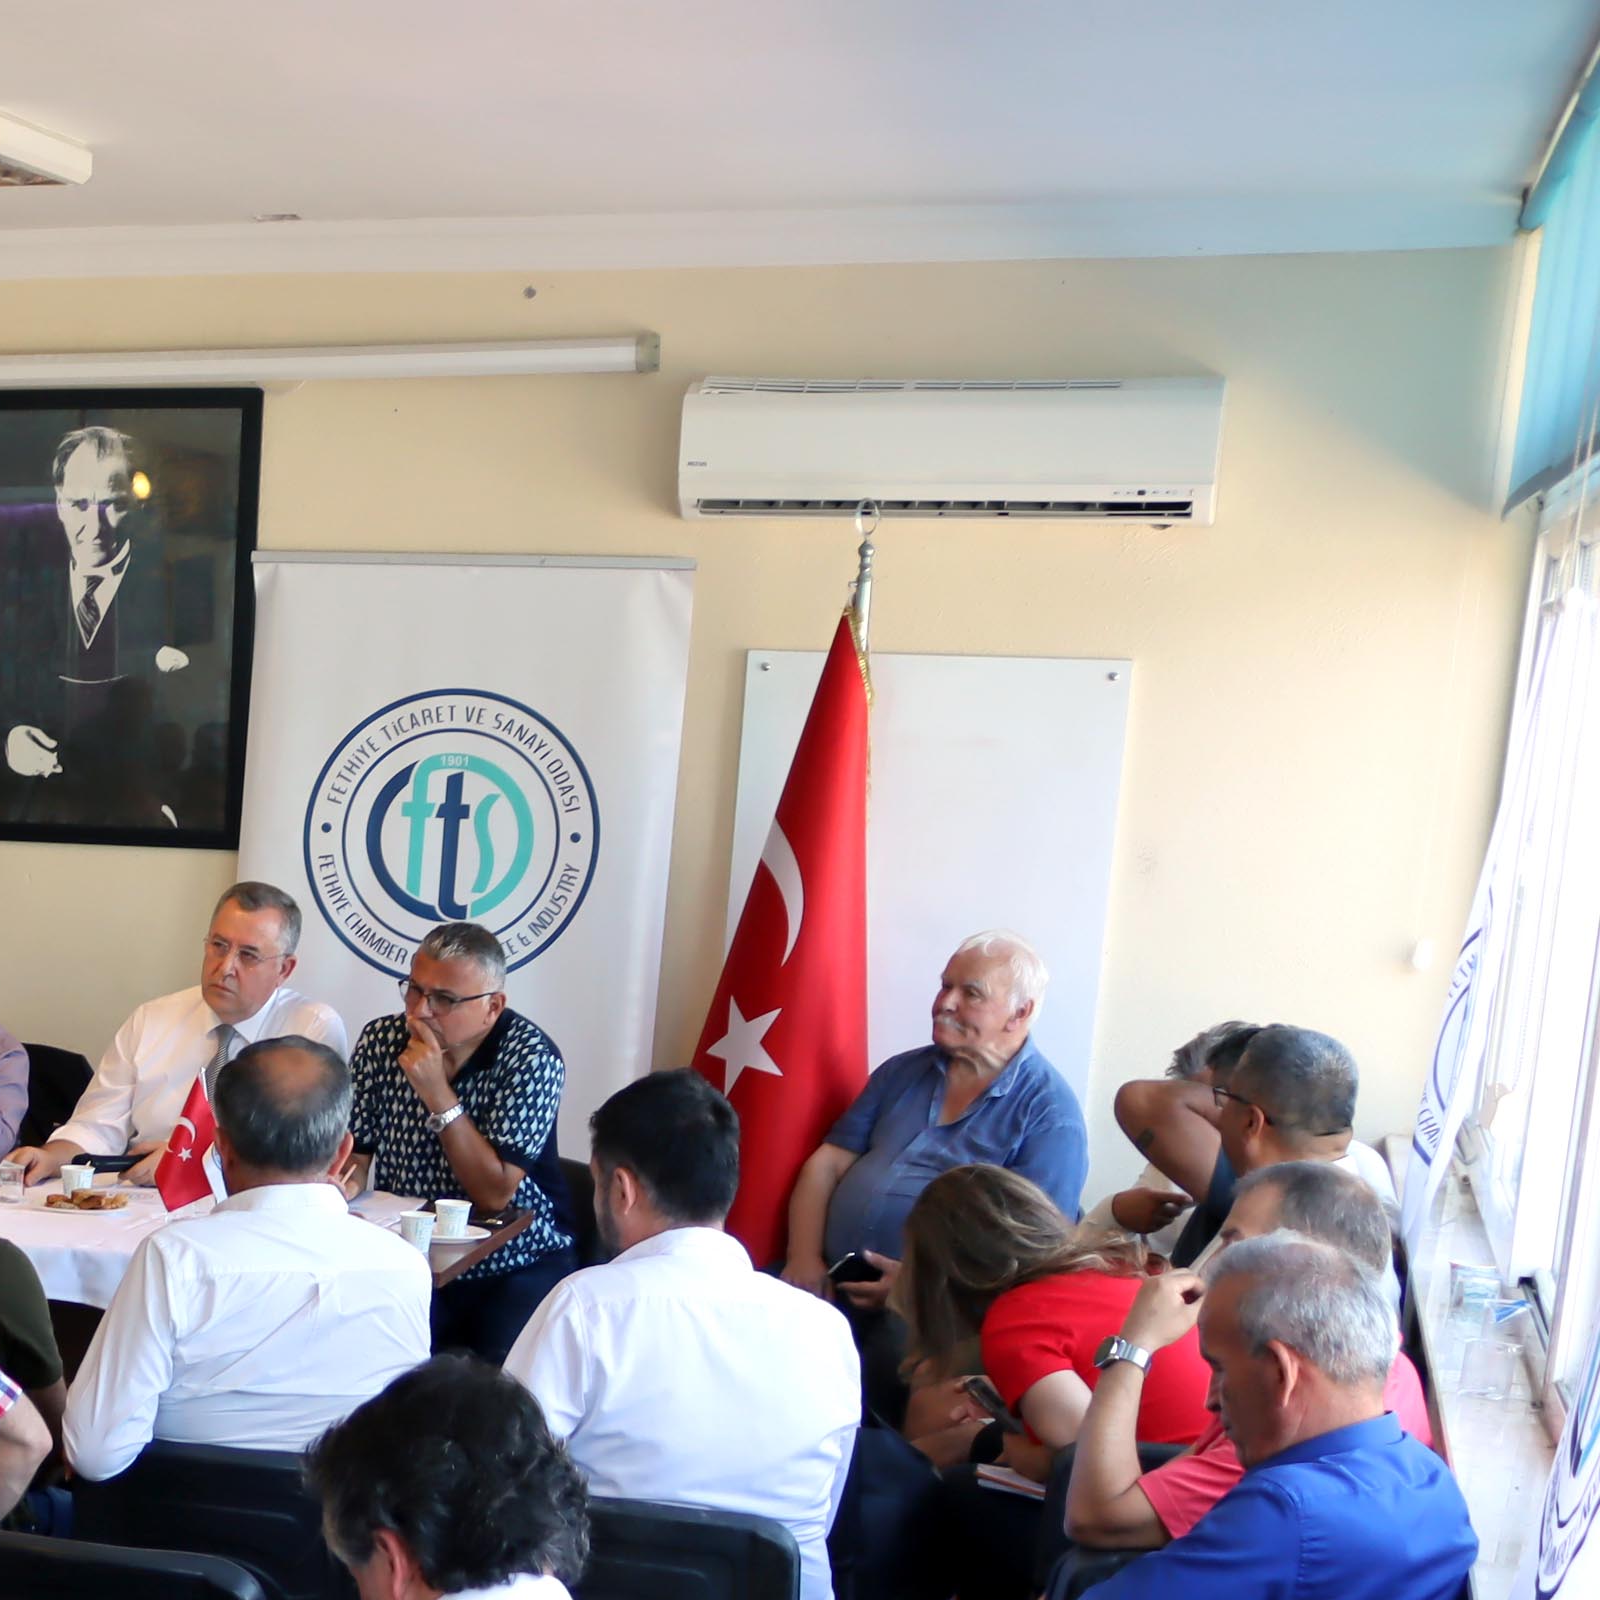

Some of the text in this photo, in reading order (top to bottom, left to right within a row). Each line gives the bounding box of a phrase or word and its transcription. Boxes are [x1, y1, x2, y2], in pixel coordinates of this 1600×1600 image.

[327, 705, 581, 813] FETHİYE TİCARET VE SANAYİ ODASI
[440, 755, 470, 767] 1901
[528, 863, 581, 937] INDUSTRY
[344, 912, 408, 965] CHAMBER
